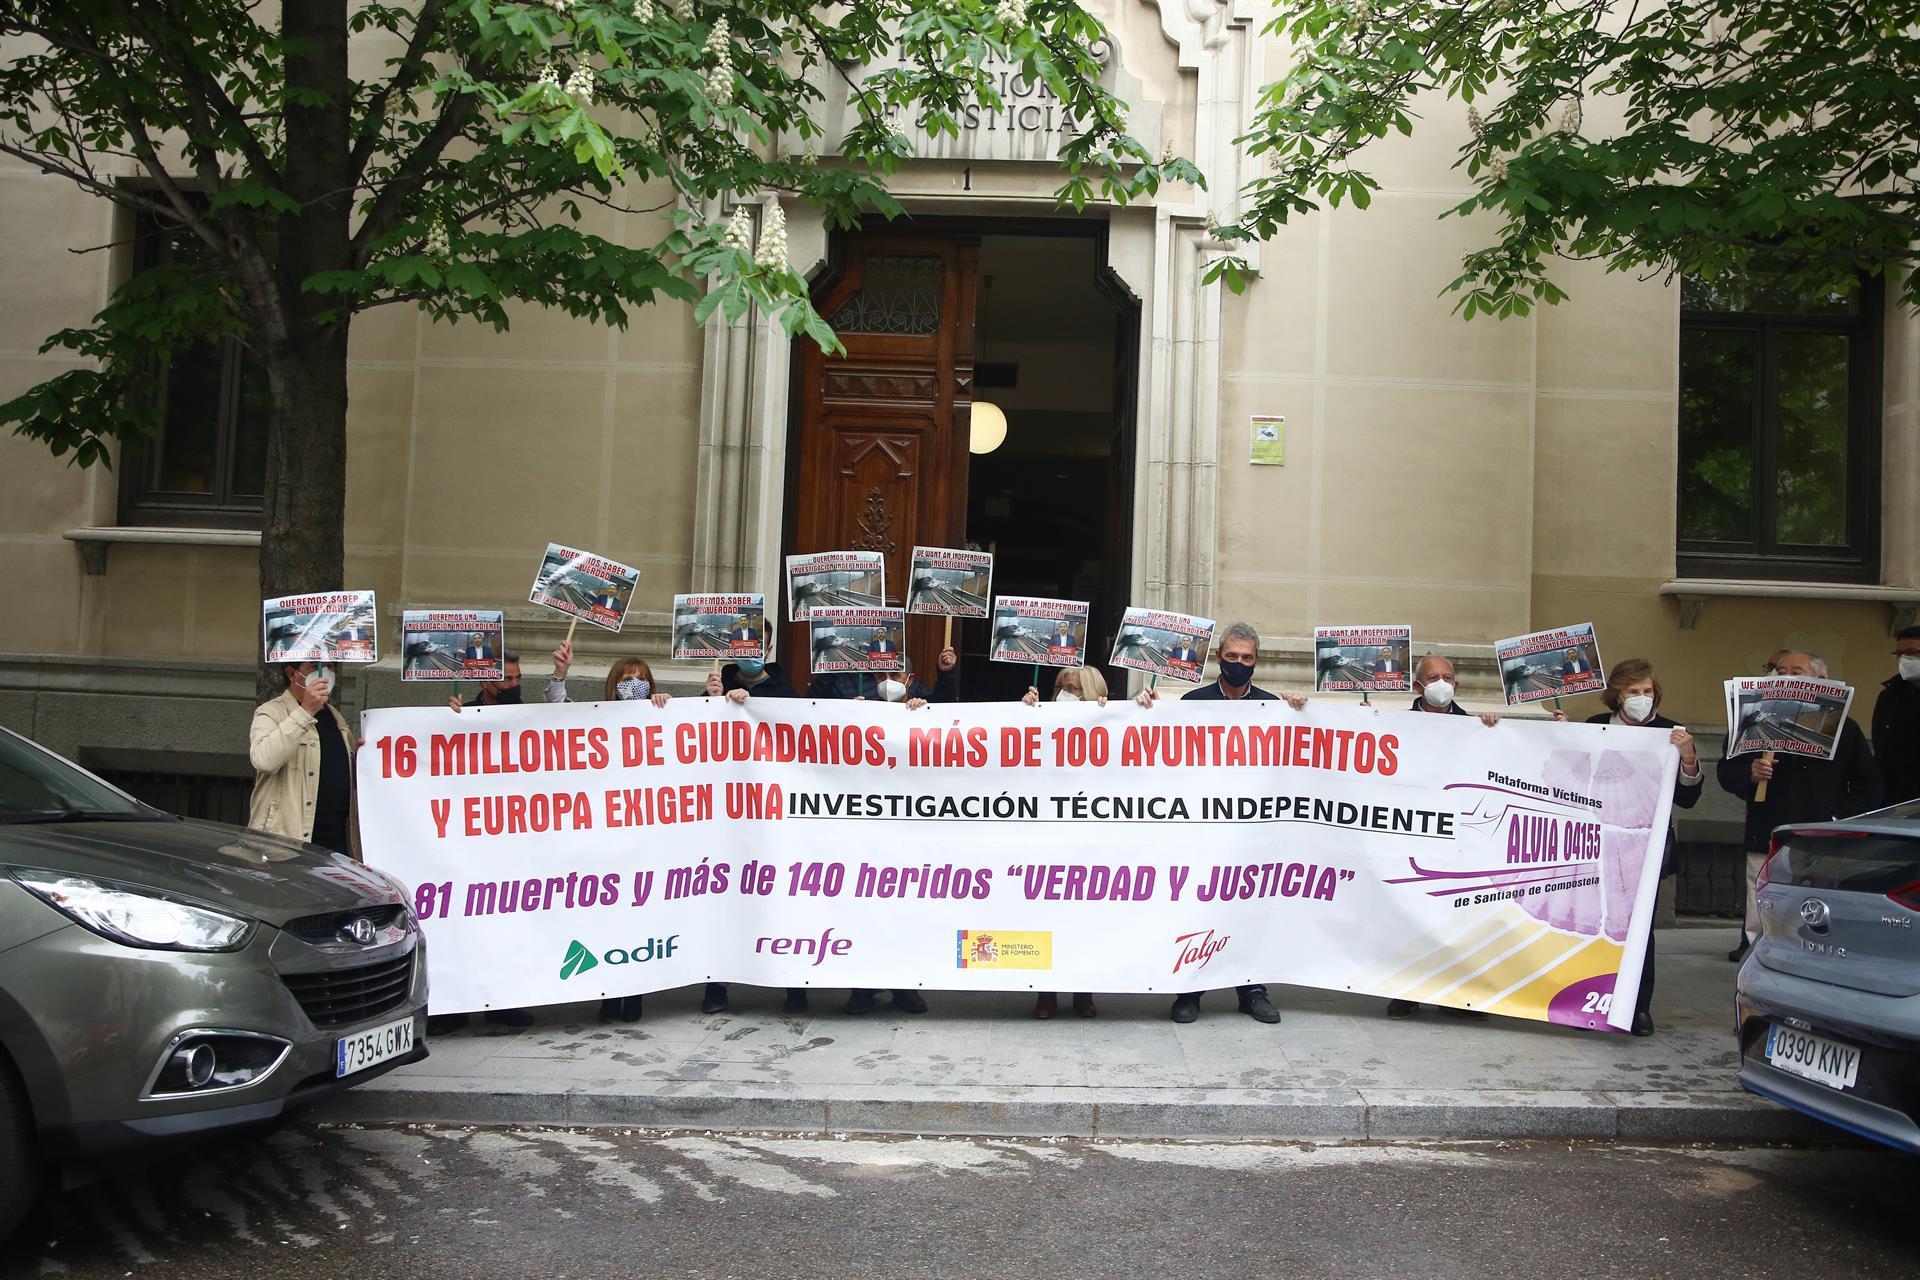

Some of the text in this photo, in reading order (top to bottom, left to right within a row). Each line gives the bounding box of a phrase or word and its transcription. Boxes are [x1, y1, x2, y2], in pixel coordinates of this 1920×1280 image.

[963, 167, 972, 191] 1
[812, 554, 844, 563] QUEREMOS
[835, 562, 879, 570] INDEPENDIENTE
[932, 560, 972, 570] INVESTIGATION
[582, 565, 610, 580] VERDAD
[602, 562, 626, 576] SABER
[280, 596, 328, 608] QUEREMOS
[687, 597, 751, 605] QUEREMOS SABER
[1040, 602, 1086, 612] INDEPENDIENT
[296, 607, 306, 615] LA
[544, 595, 576, 612] FALLECIDOS
[594, 612, 618, 629] HERIDOS
[1017, 609, 1065, 619] INVESTIGATION
[1148, 612, 1190, 624] QUEREMOS UNA
[1167, 624, 1210, 638] INDEPENDIENTE
[1520, 631, 1568, 645] QUEREMOS UNA
[1546, 637, 1592, 649] INDEPENDIENTE
[1007, 651, 1027, 659] DEADS
[1049, 655, 1077, 664] INJURED
[1122, 657, 1155, 670] FALLECIDOS
[1173, 668, 1199, 680] HERIDOS
[1518, 690, 1552, 700] FALLECIDOS
[1574, 681, 1600, 690] HERIDOS
[1741, 681, 1754, 689] WE
[1757, 681, 1774, 689] WANT
[1786, 680, 1846, 697] INDEPENDIENT
[1763, 690, 1816, 701] INVESTIGATION
[376, 720, 1399, 778] 16 MILLONES DE CIUDADANOS, MÁS DE 100 AYUNTAMIENTOS
[1744, 741, 1760, 749] DEADS
[1774, 740, 1784, 748] 140
[1786, 741, 1824, 754] INJURED
[1487, 771, 1602, 808] Plataforma Víctimas
[430, 782, 1454, 838] Y EUROPA EXIGEN UNA INVESTIGACIÓN TÉCNICA INDEPENDIENTE
[1506, 814, 1600, 864] ALVIA 04155
[415, 857, 1356, 920] 81 muertos y más de 140 heridos “VERDAD Y JUSTICIA”
[1454, 876, 1600, 908] de Santiago de Compostela
[604, 934, 680, 965] adif
[755, 928, 852, 966] renfe
[1172, 929, 1230, 974] Talgo
[1801, 939, 1846, 958] IONIQ
[1580, 991, 1613, 1015] 24
[348, 1022, 410, 1070] 7354 GWX
[1776, 1030, 1855, 1080] 0390 KNY
